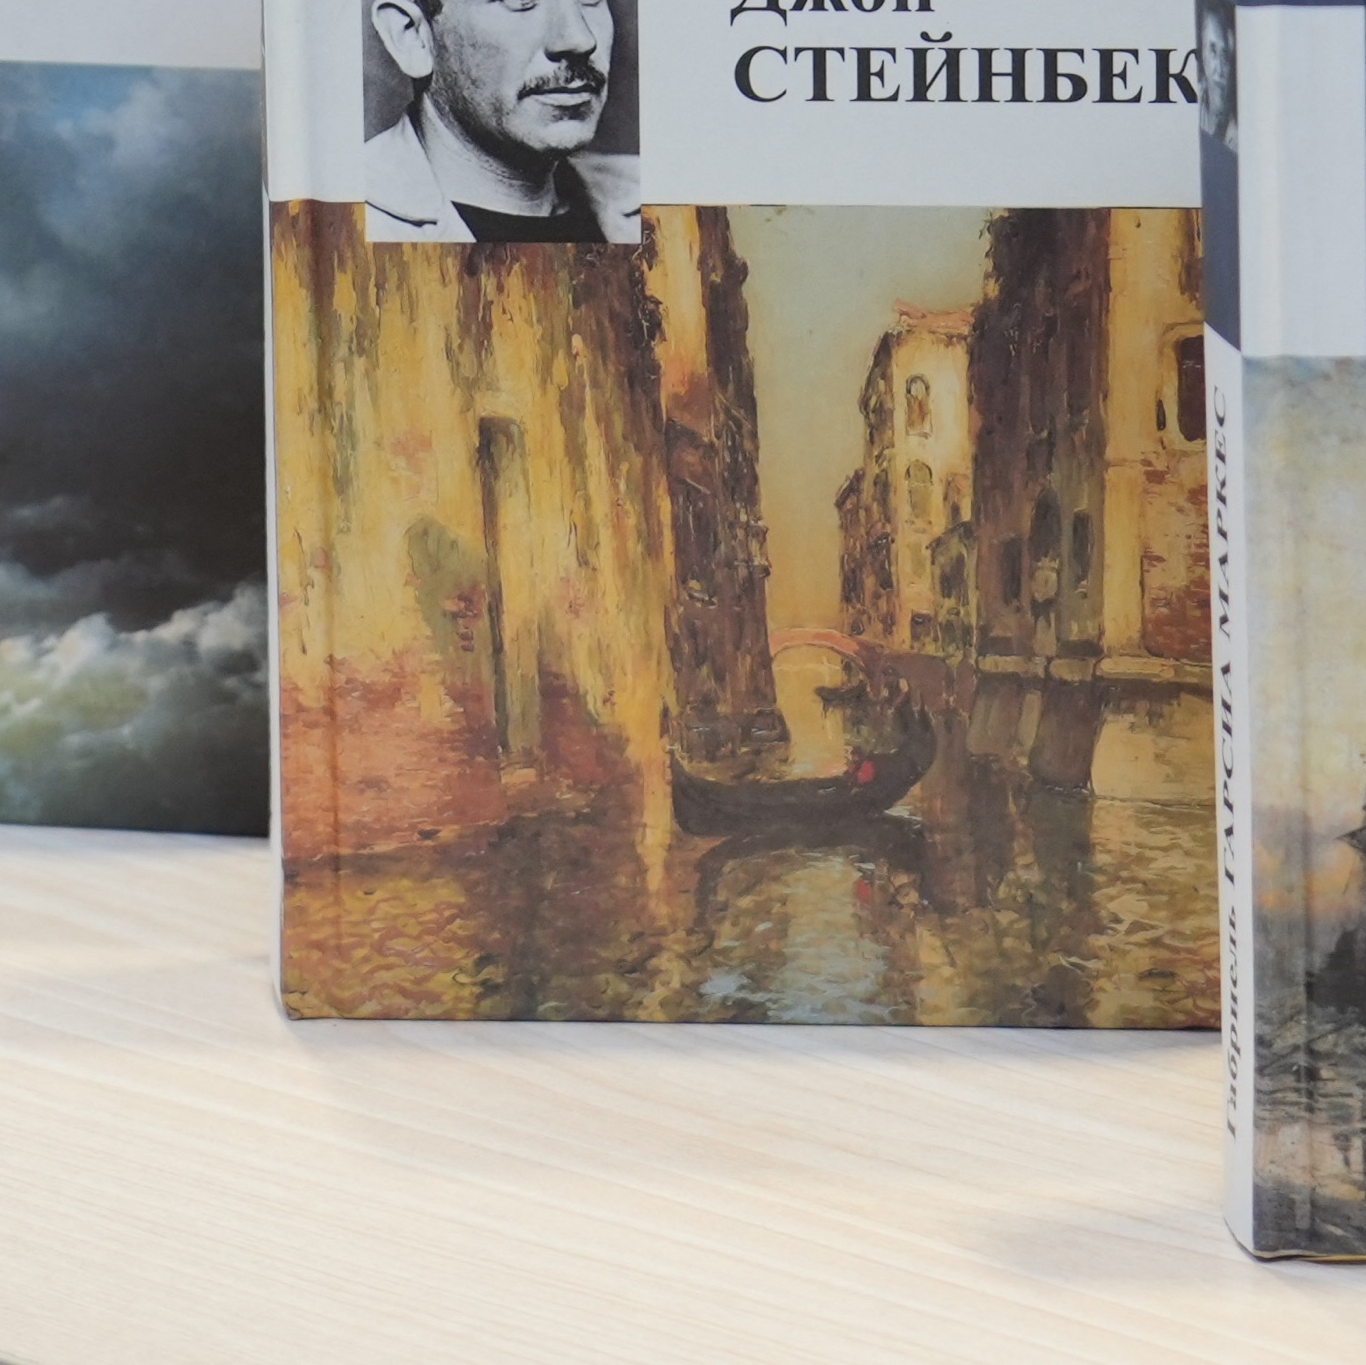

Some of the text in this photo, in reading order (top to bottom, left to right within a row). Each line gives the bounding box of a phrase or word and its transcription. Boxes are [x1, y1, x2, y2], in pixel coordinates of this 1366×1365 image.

[733, 30, 1199, 104] СТЕЙНБЕК
[1212, 384, 1243, 1141] Габриель ГАРСИА МАРКЕС
